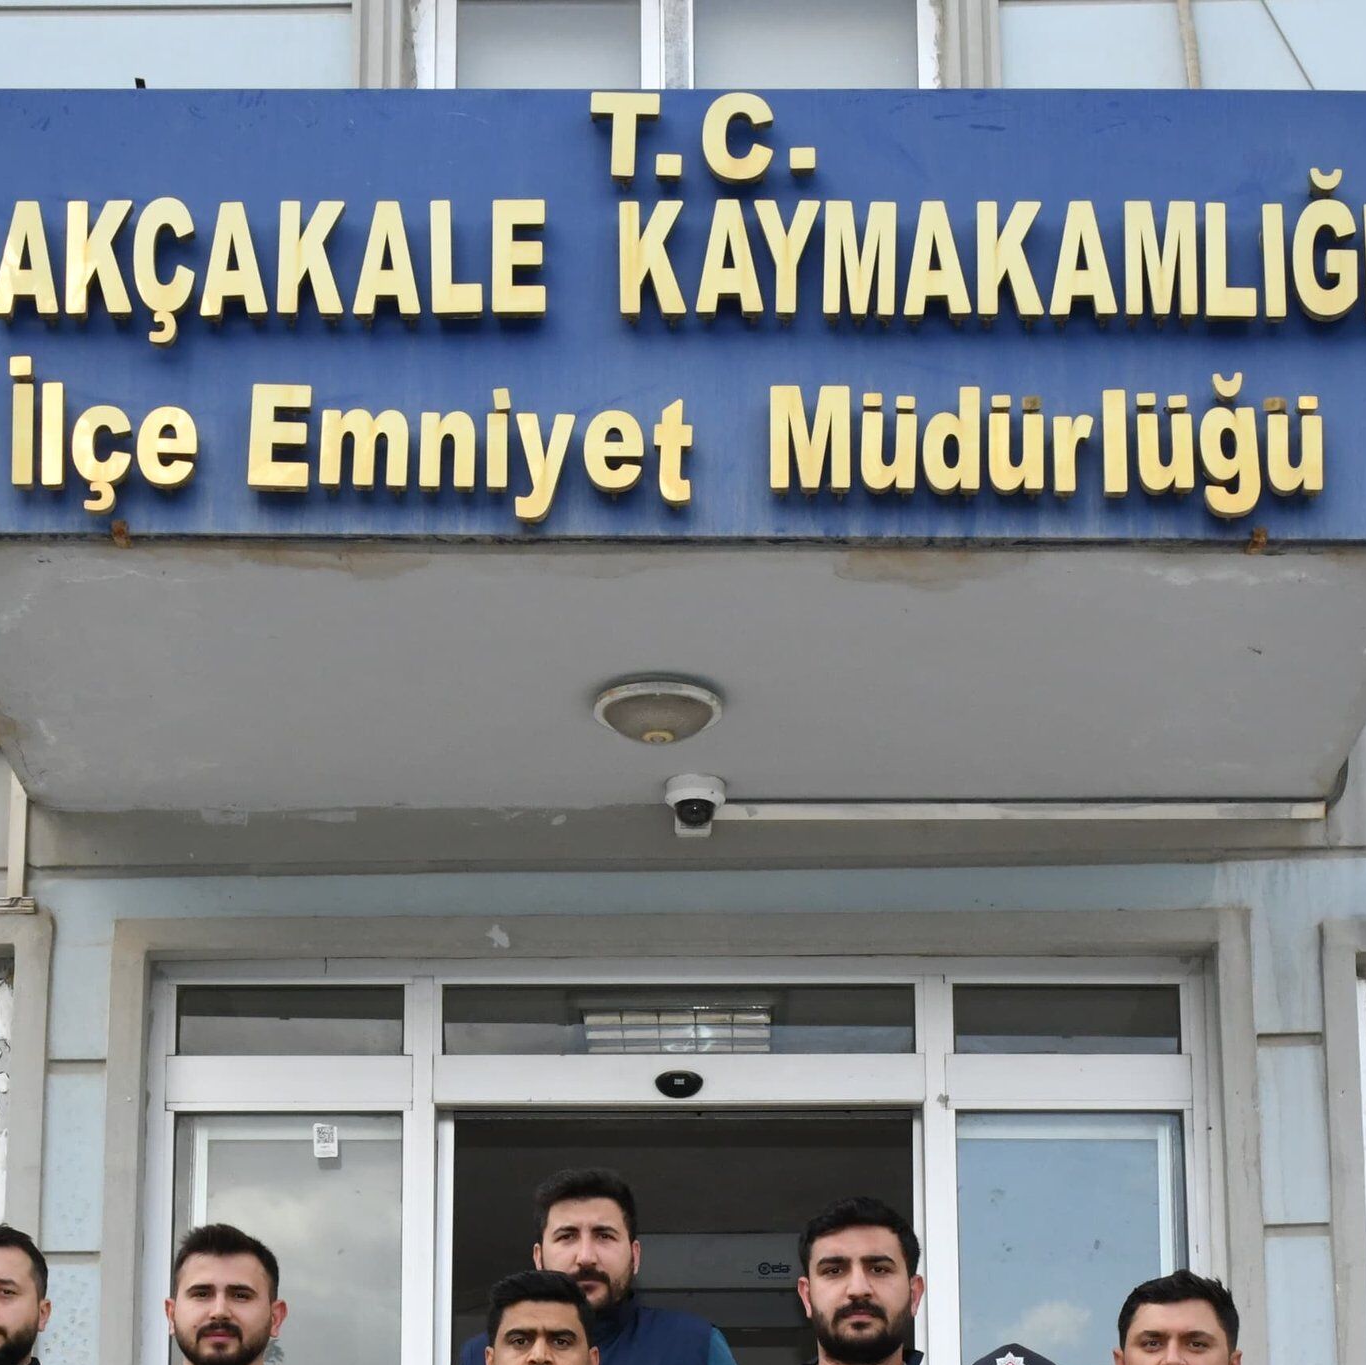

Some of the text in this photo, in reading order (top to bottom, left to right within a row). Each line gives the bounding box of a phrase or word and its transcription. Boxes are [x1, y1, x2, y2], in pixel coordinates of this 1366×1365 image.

[589, 91, 817, 185] T.C.
[8, 355, 1325, 523] İlçe Emniyet Müdürlüğü
